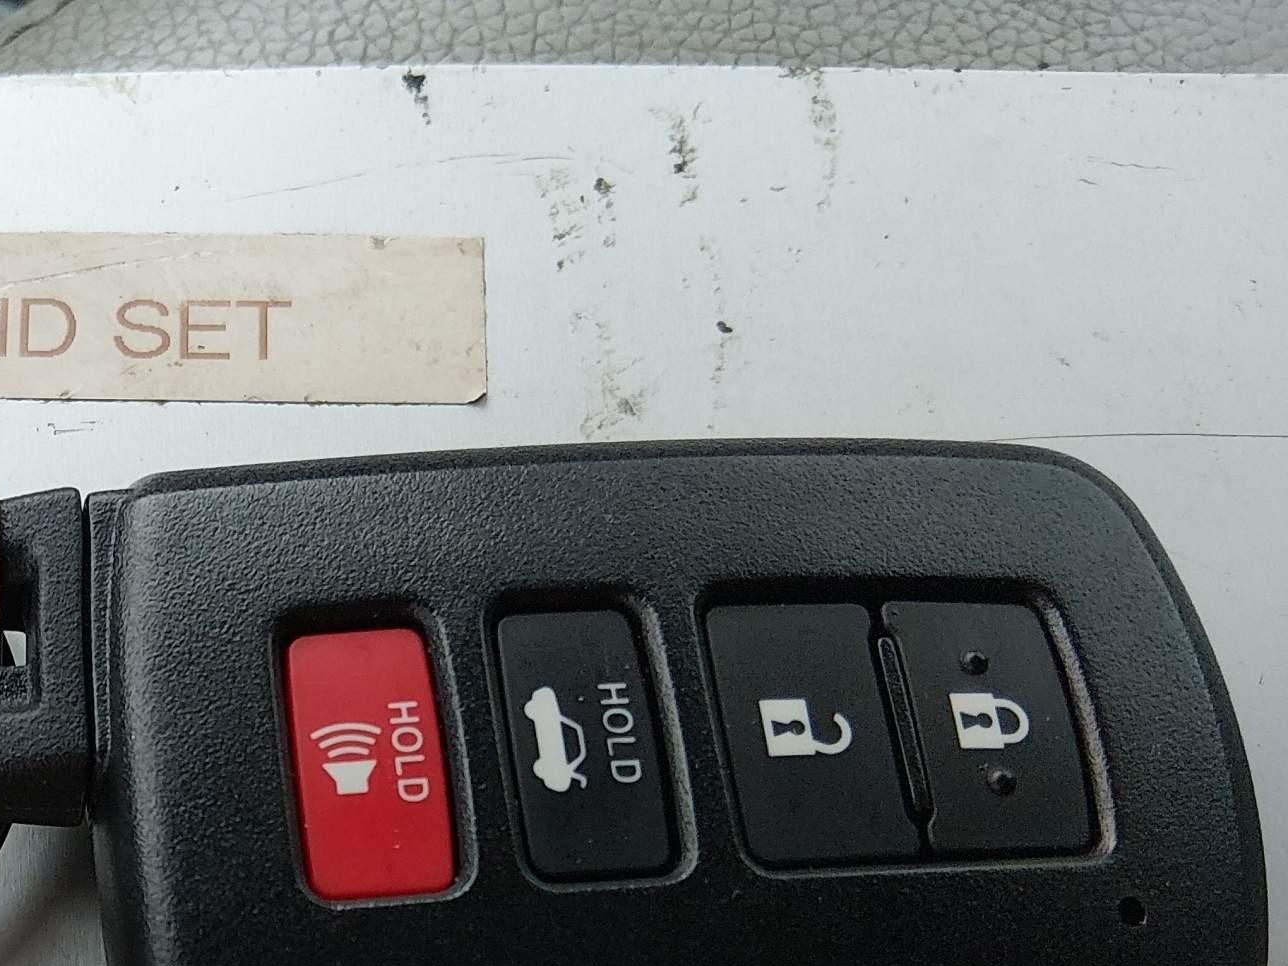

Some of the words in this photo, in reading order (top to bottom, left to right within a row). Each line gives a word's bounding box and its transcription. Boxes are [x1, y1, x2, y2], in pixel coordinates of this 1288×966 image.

[113, 298, 293, 361] SET
[387, 700, 430, 802] HOLD
[597, 682, 643, 784] HOLD
